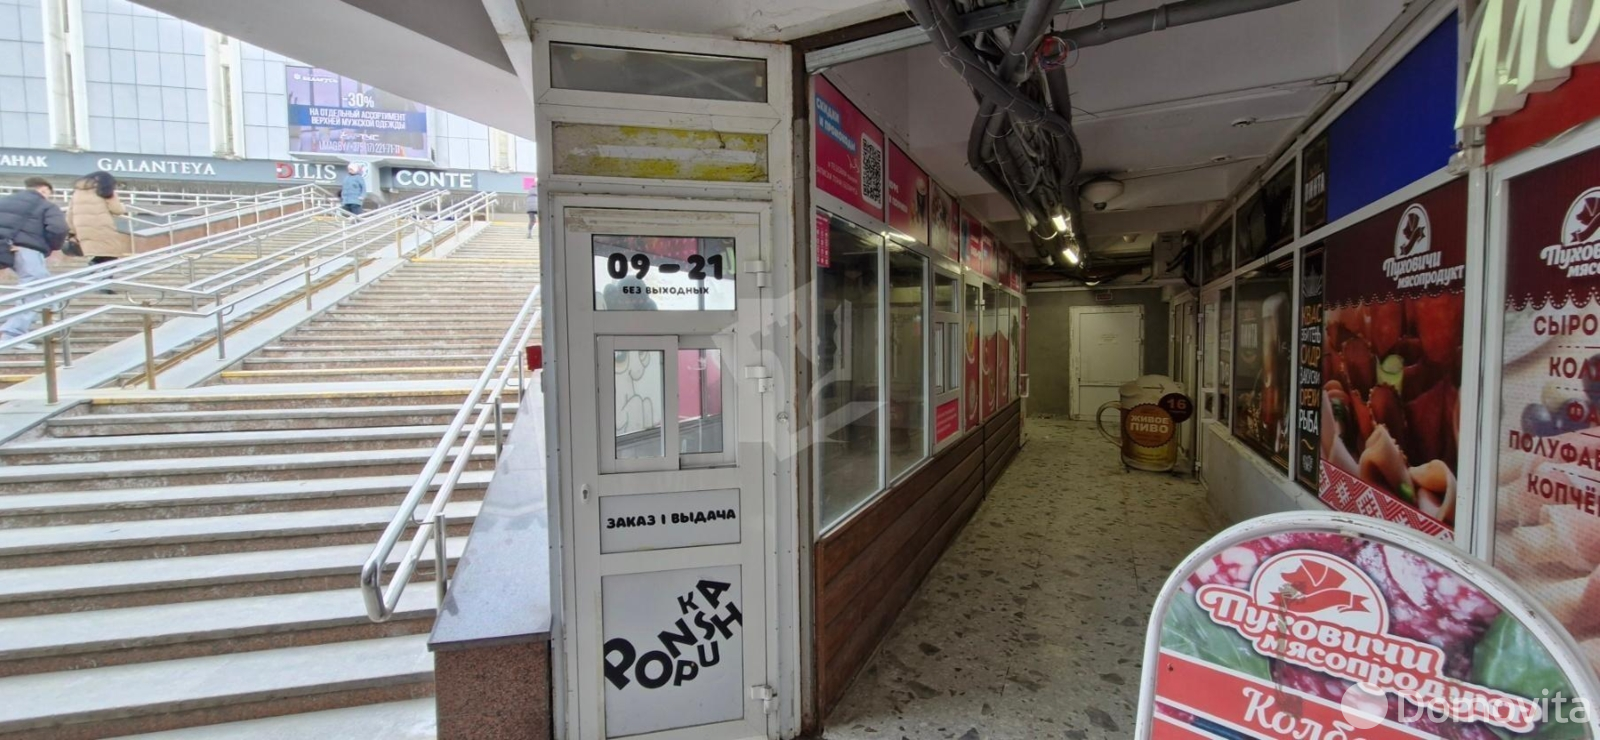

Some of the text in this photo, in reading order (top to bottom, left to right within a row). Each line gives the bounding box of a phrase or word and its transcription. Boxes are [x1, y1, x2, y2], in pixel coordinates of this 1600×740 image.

[342, 92, 374, 108] -30%
[309, 108, 406, 121] НА ОТДЕЛЬНЫЙ АССОРТИМЕНТ
[311, 116, 406, 130] ВЕРХНЕЙ МУЖСКОЙ ОДЕЖДЫ
[97, 157, 216, 176] GALANTEYA
[275, 161, 337, 180] DILIS
[396, 169, 473, 188] CONTE
[607, 252, 650, 280] 09
[687, 253, 723, 280] 21
[1382, 251, 1442, 281] Пуховичи
[1566, 261, 1600, 278] мяс
[622, 286, 709, 295] БЕЗ ВЫХОДНЫХ
[1301, 303, 1322, 326] КВАС
[1166, 398, 1187, 410] 16
[1129, 422, 1169, 434] ПИВО
[1130, 414, 1170, 425] ЖИВОЕ
[1298, 409, 1319, 436] РЫБА
[1527, 473, 1600, 517] КОПЧЁ
[606, 515, 656, 529] ЗАКАЗ
[671, 508, 736, 524] ВЫДАЧА
[1203, 590, 1433, 673] Пуховичи
